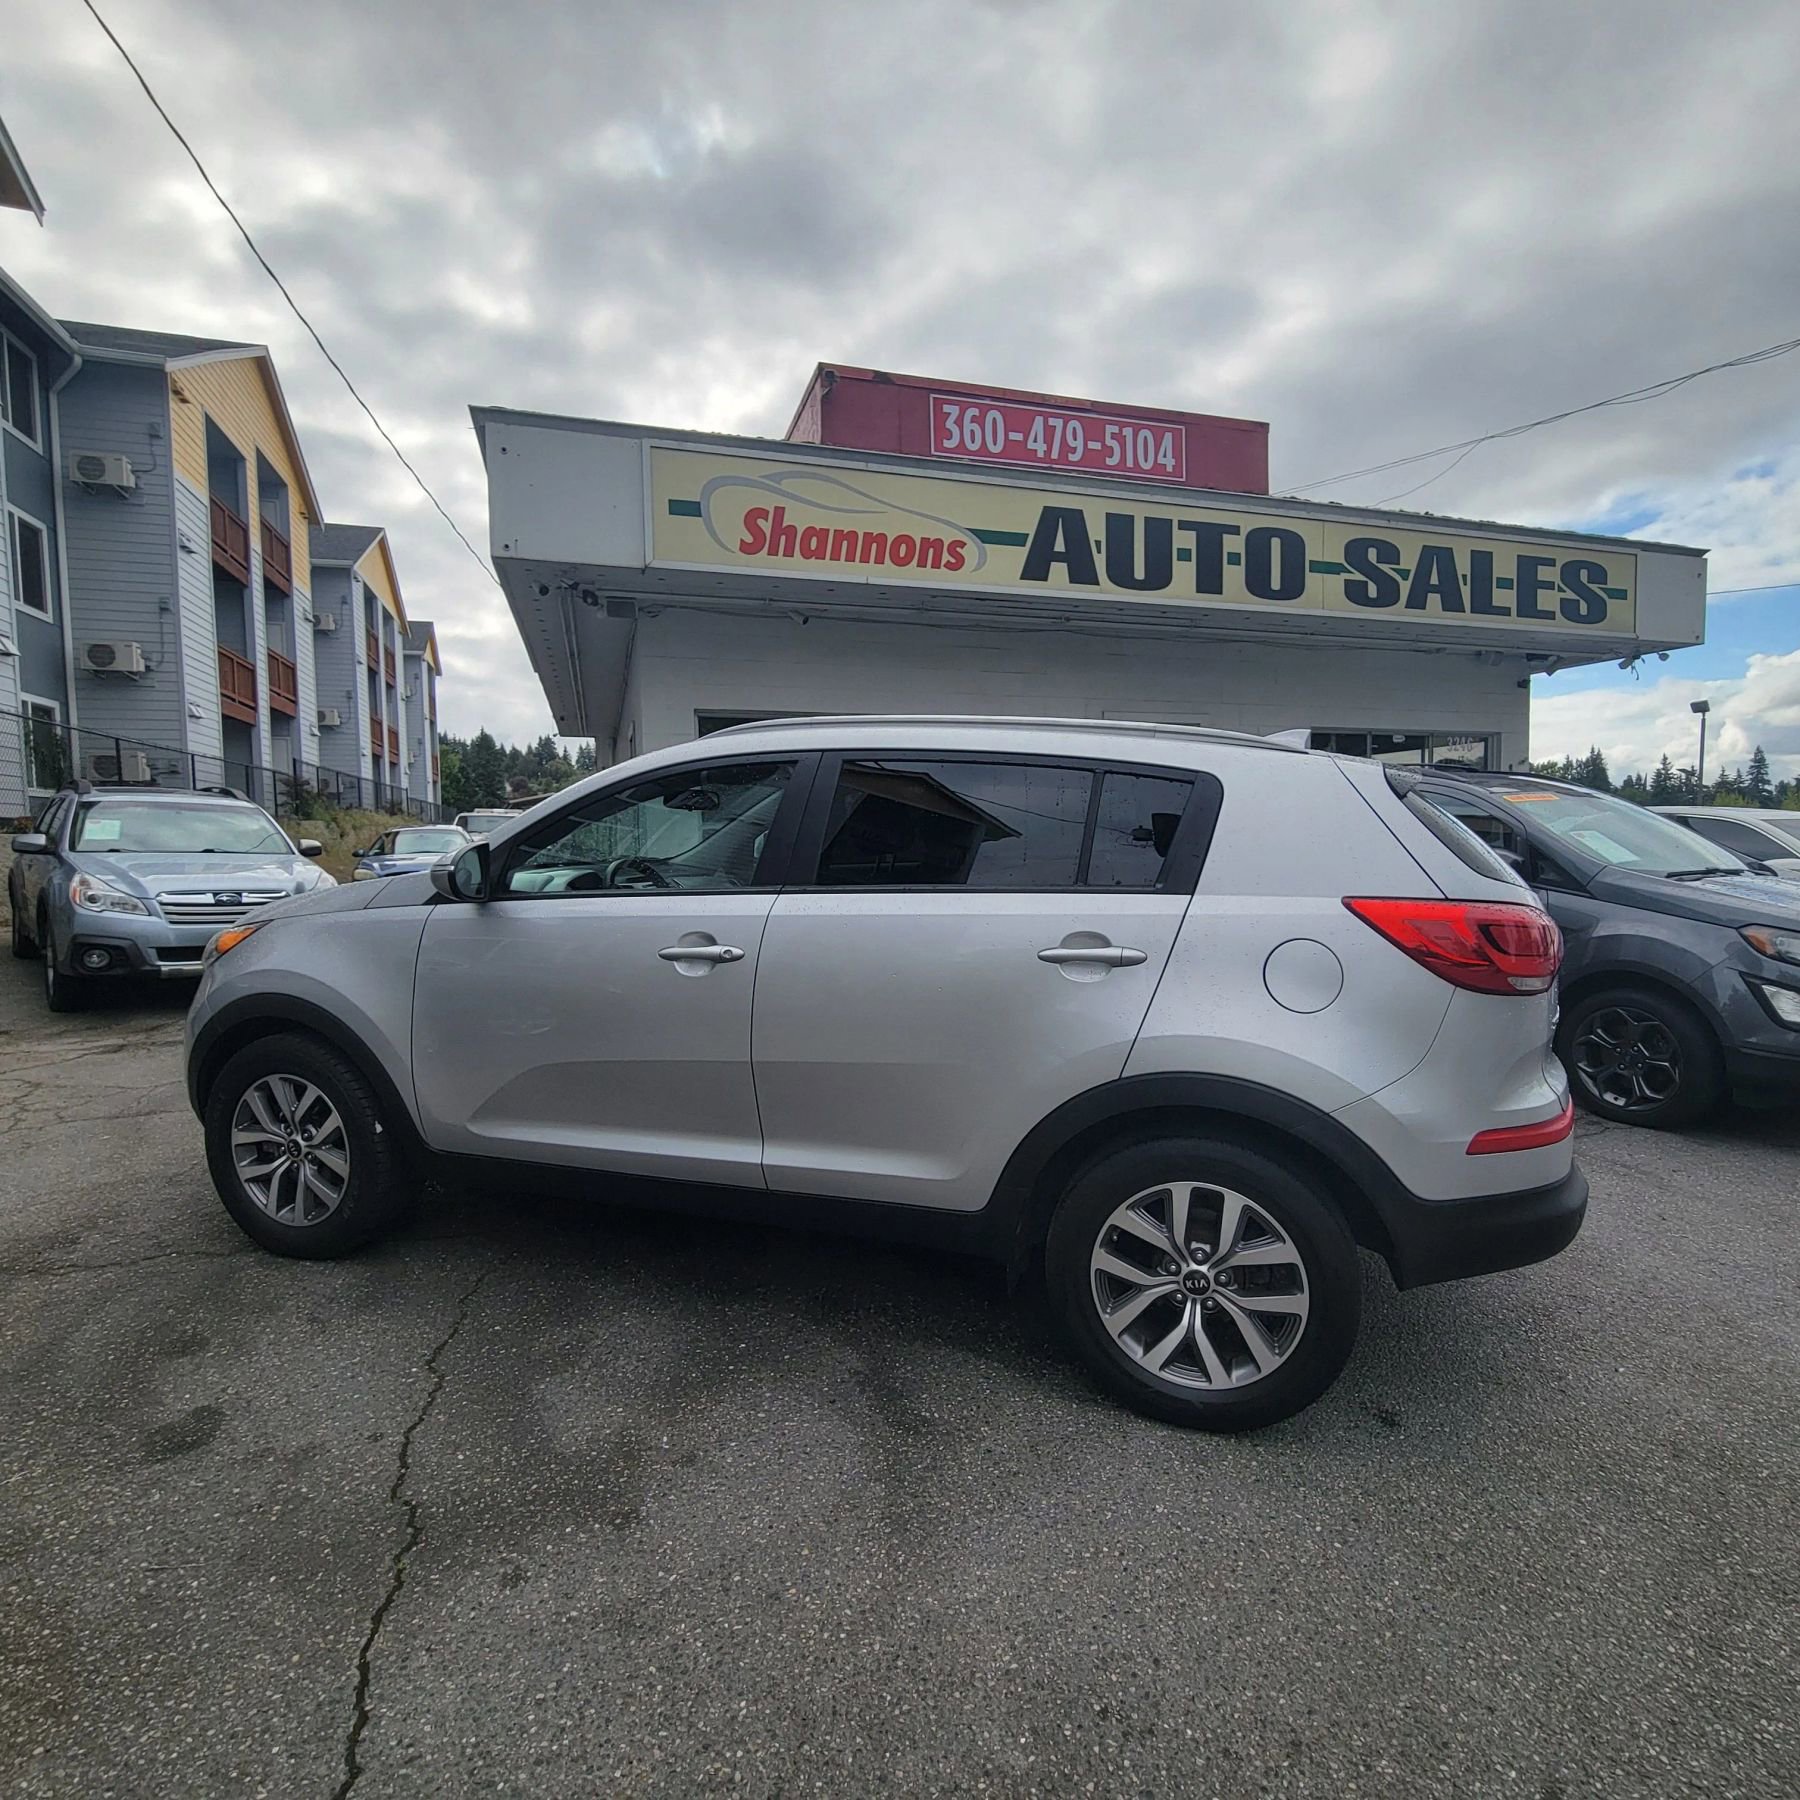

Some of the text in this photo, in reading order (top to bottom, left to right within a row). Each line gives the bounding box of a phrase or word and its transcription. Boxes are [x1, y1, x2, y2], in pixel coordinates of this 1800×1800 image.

[941, 403, 1177, 473] 360-479-5104
[738, 505, 1609, 625] Shannons AUTO SALES
[1185, 1279, 1208, 1289] KIA
